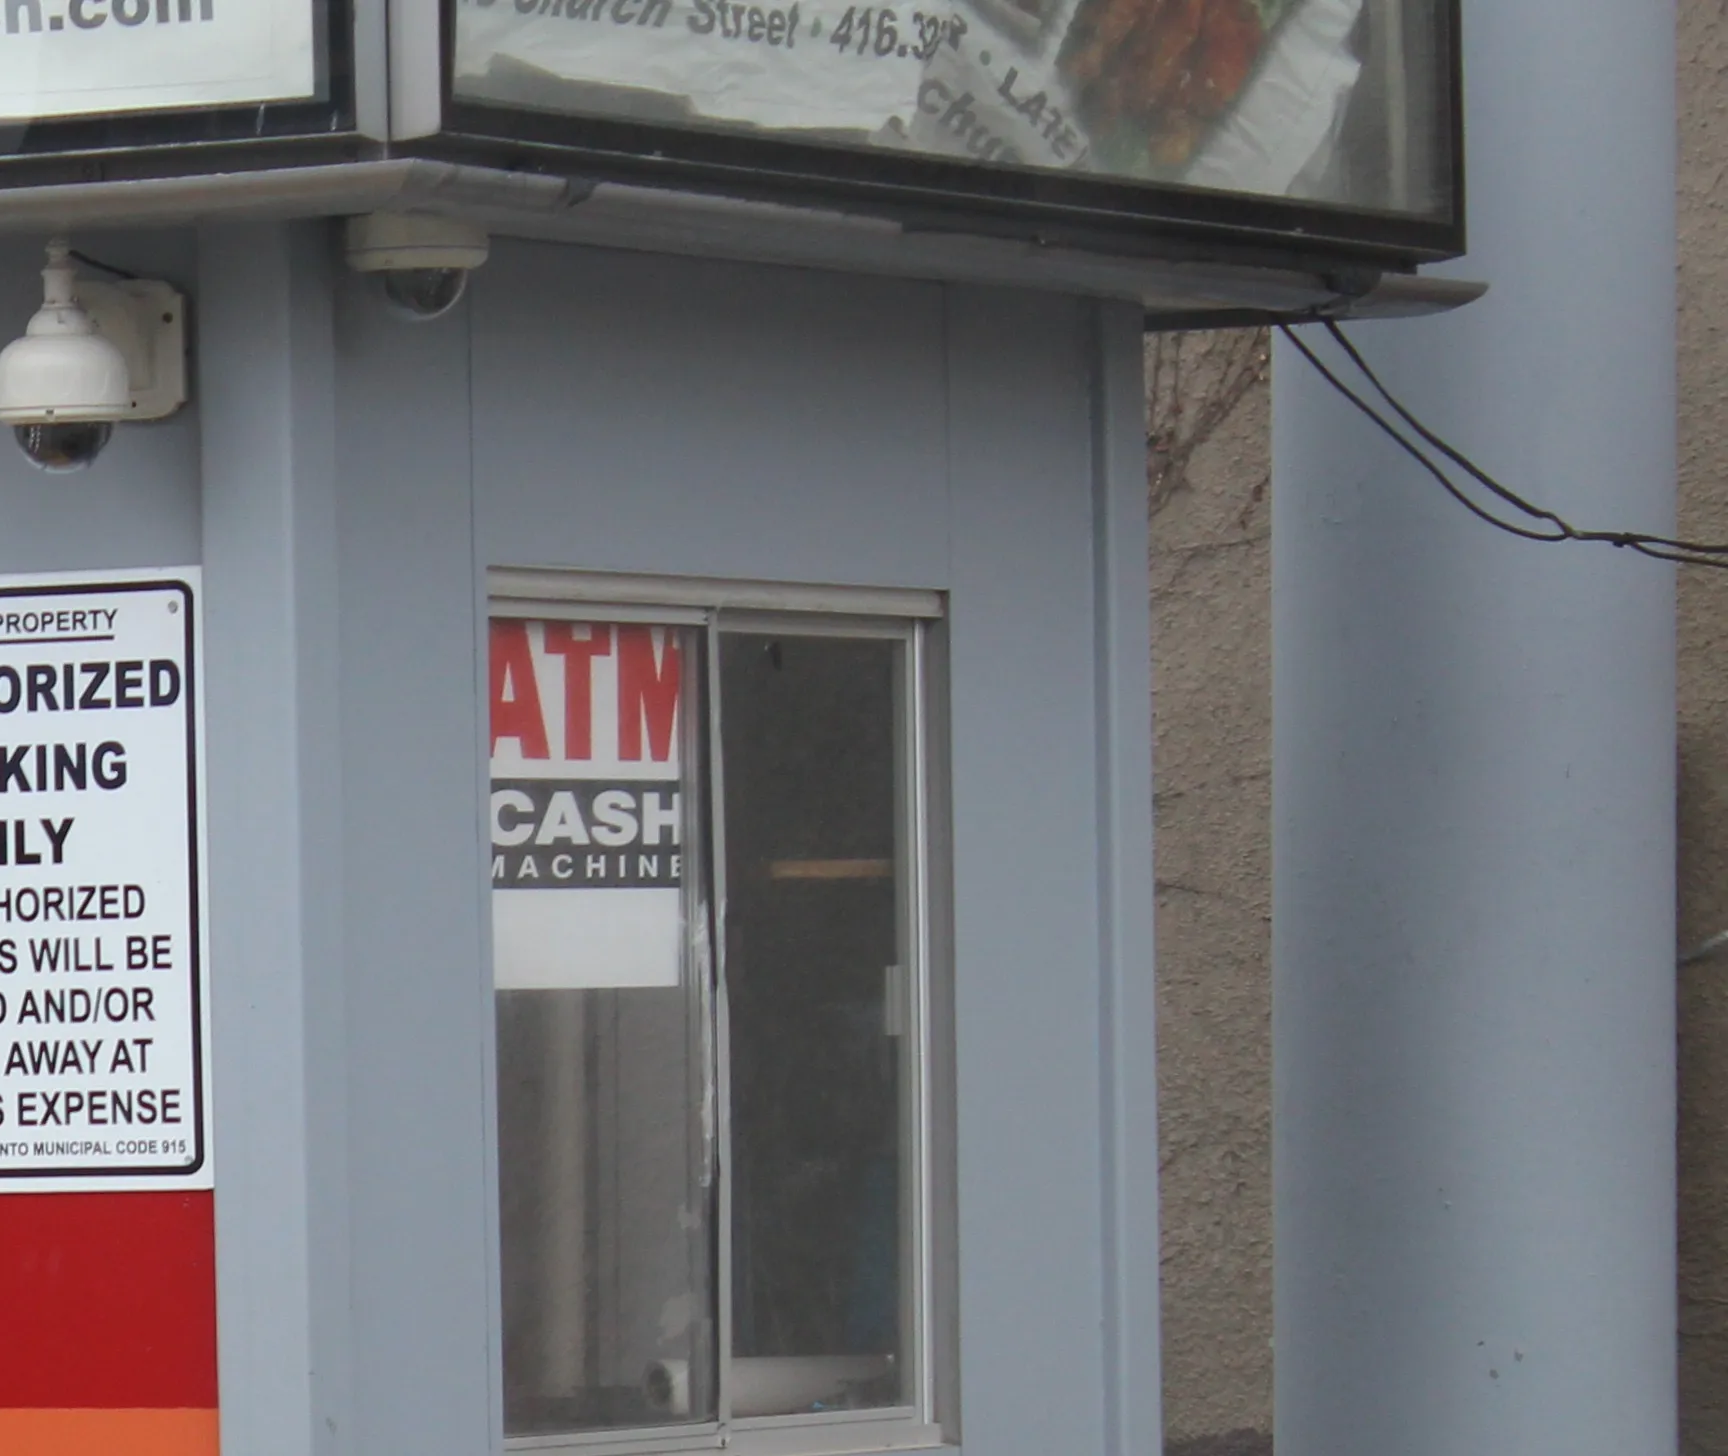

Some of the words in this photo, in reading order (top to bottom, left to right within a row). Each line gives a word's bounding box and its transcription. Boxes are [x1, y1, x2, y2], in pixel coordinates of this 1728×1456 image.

[489, 619, 681, 762] ATM
[490, 790, 681, 847] CASH
[30, 937, 113, 973] WILL
[126, 935, 172, 970] BE
[17, 987, 155, 1024] AND/OR
[4, 1039, 105, 1075] AWAY
[110, 1038, 153, 1073] AT
[19, 1090, 181, 1127] EXPENSE
[33, 1140, 112, 1157] MUNICIPAL
[116, 1139, 157, 1155] CODE
[162, 1139, 187, 1155] 915
